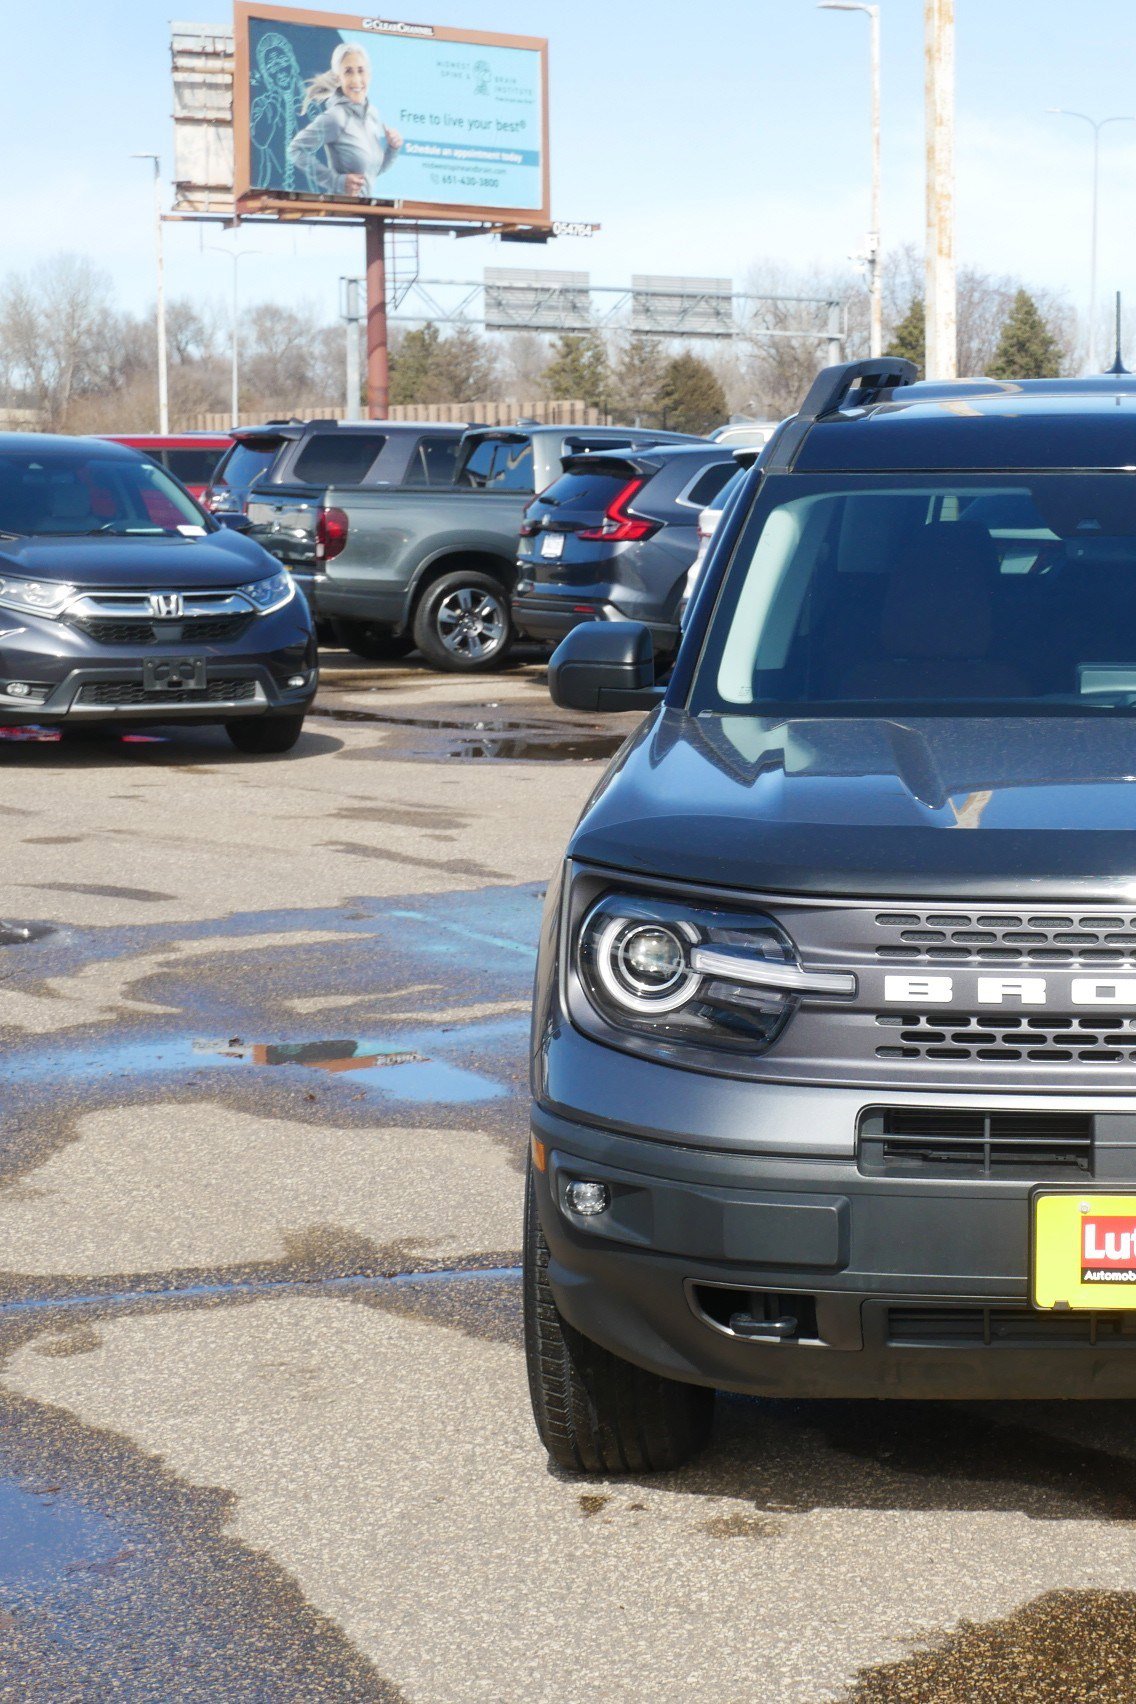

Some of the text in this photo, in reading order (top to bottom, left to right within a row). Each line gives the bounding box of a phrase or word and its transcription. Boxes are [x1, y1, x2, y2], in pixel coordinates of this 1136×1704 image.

[400, 109, 426, 124] Free
[429, 113, 441, 126] to
[443, 113, 465, 128] live
[468, 118, 493, 131] your
[405, 142, 441, 155] Schedule
[453, 148, 501, 160] appointment
[501, 151, 524, 164] today
